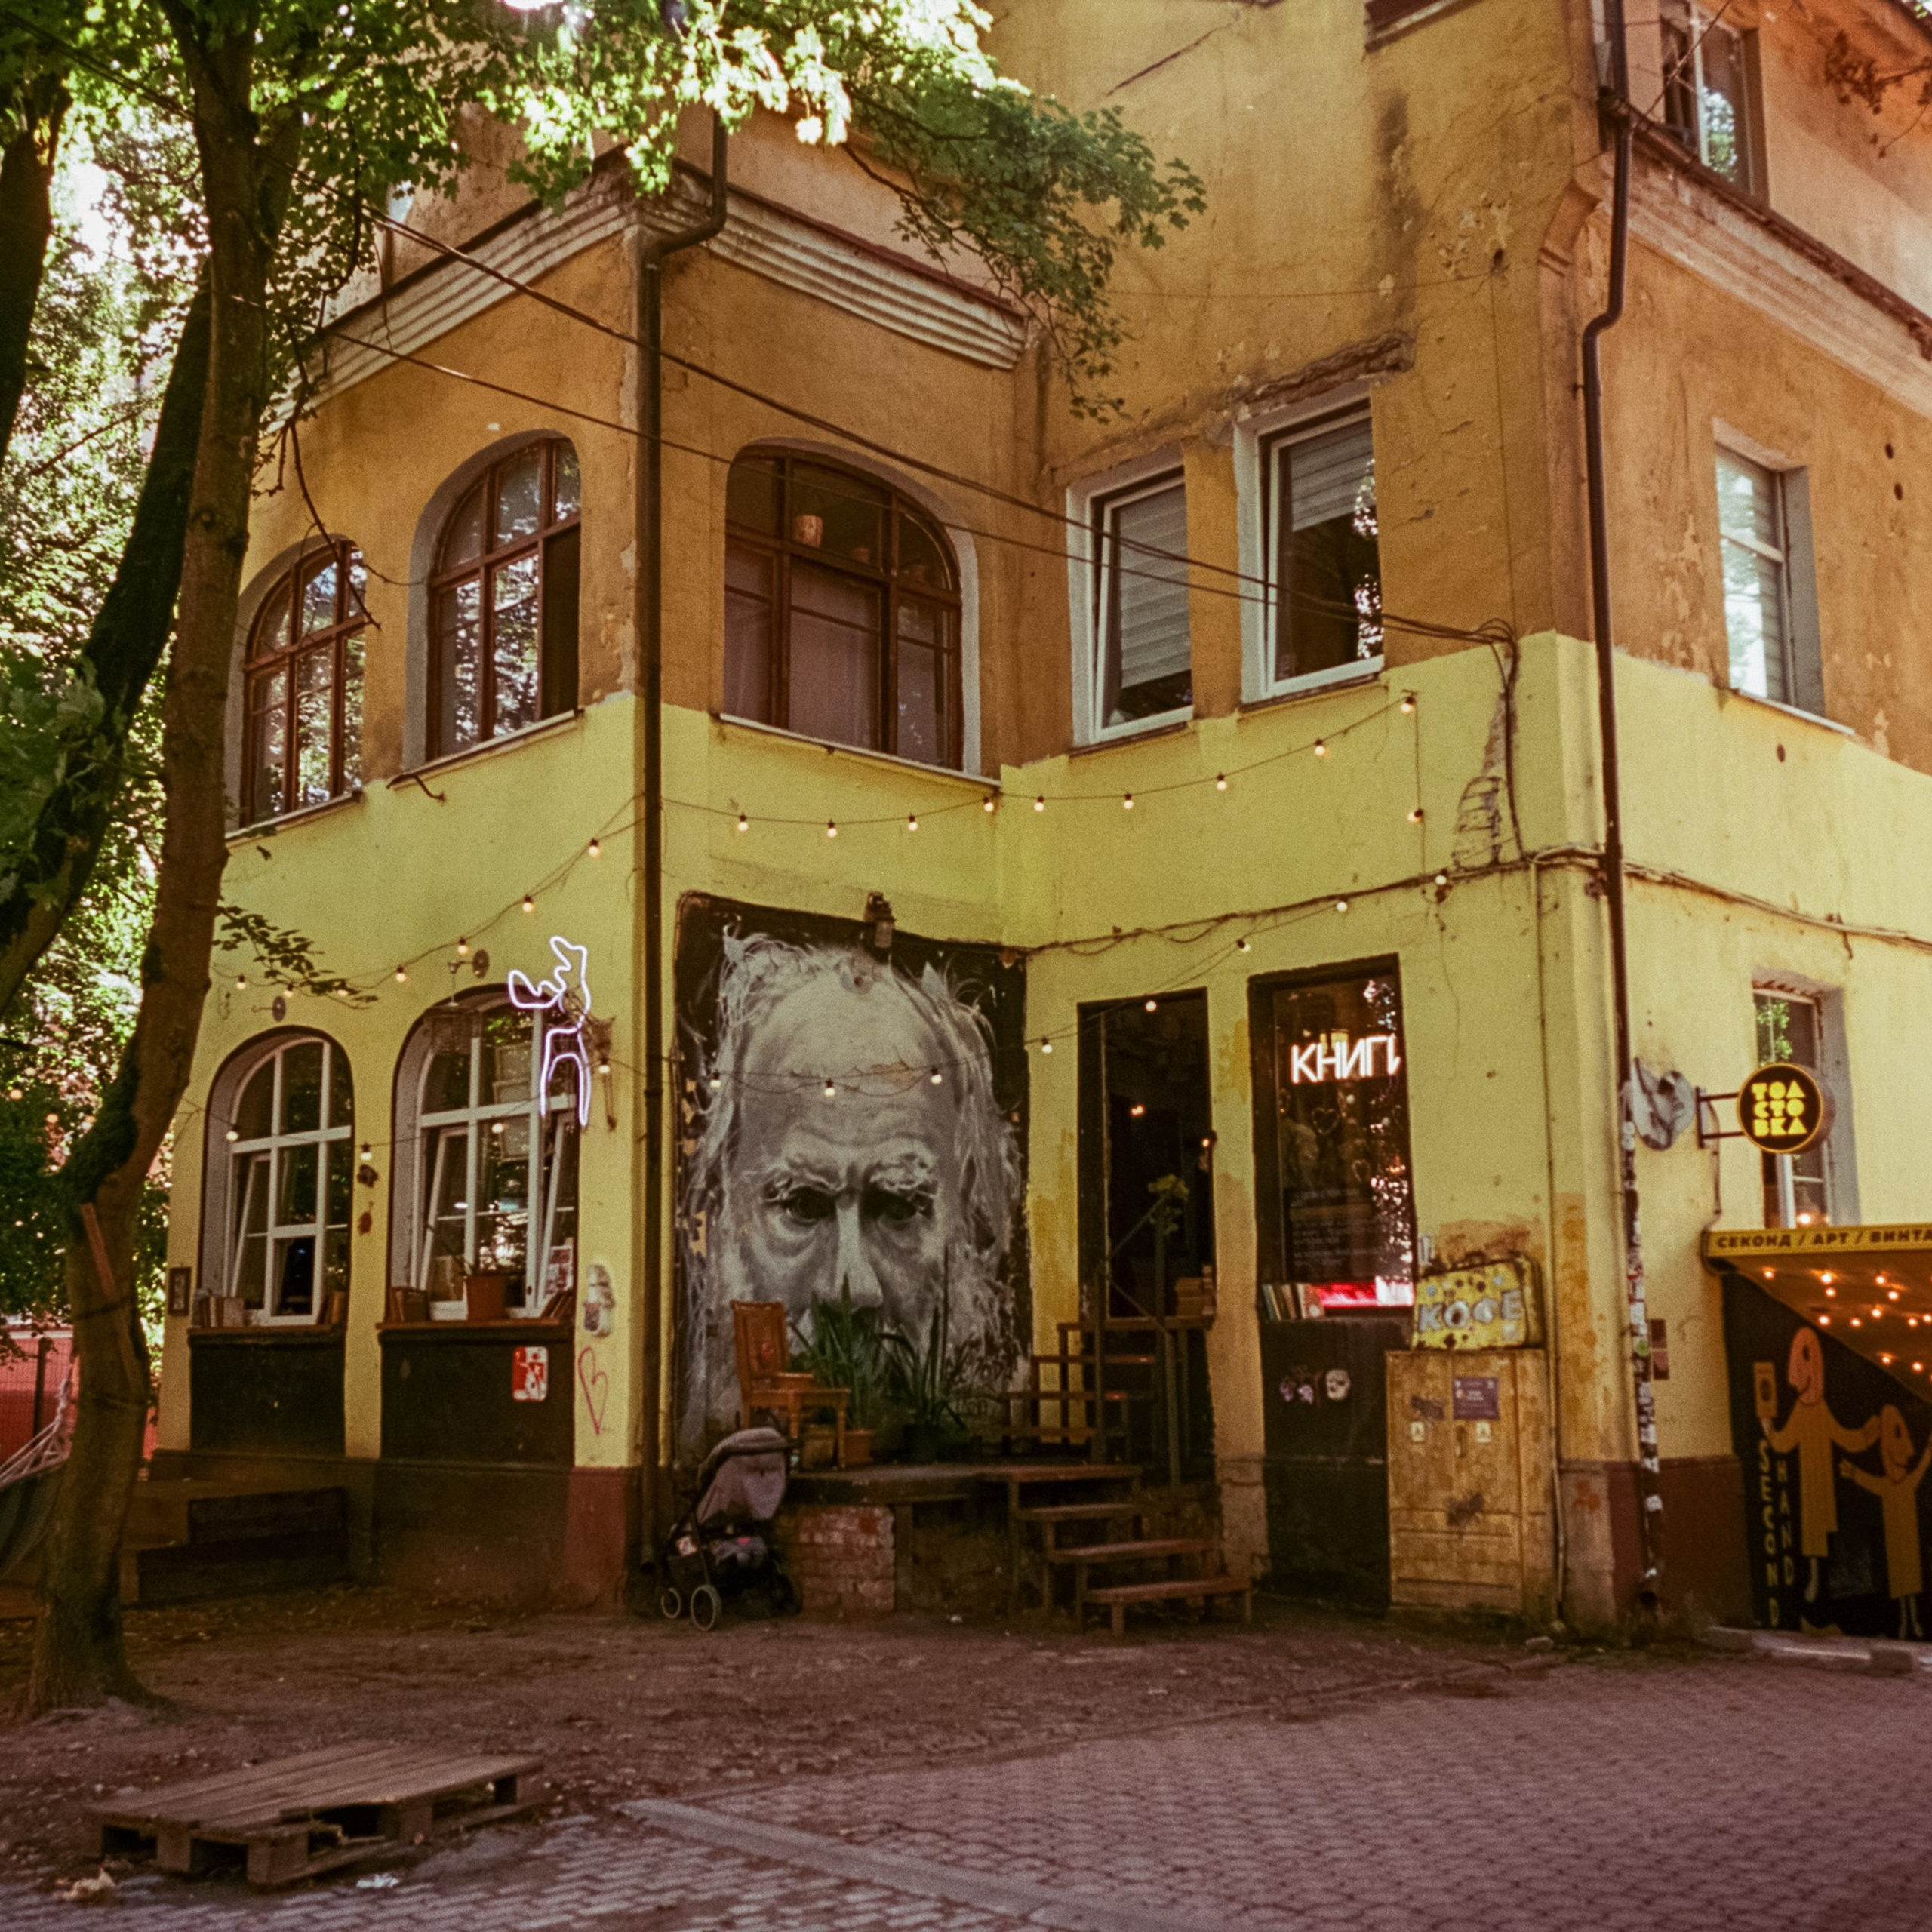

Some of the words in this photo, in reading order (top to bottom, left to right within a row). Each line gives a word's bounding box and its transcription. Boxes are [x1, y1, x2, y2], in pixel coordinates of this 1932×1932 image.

[1717, 1234, 1792, 1248] СЕКОНД
[1813, 1232, 1848, 1245] АРТ
[1758, 1438, 1780, 1627] SECOND
[1777, 1460, 1795, 1586] HAND
